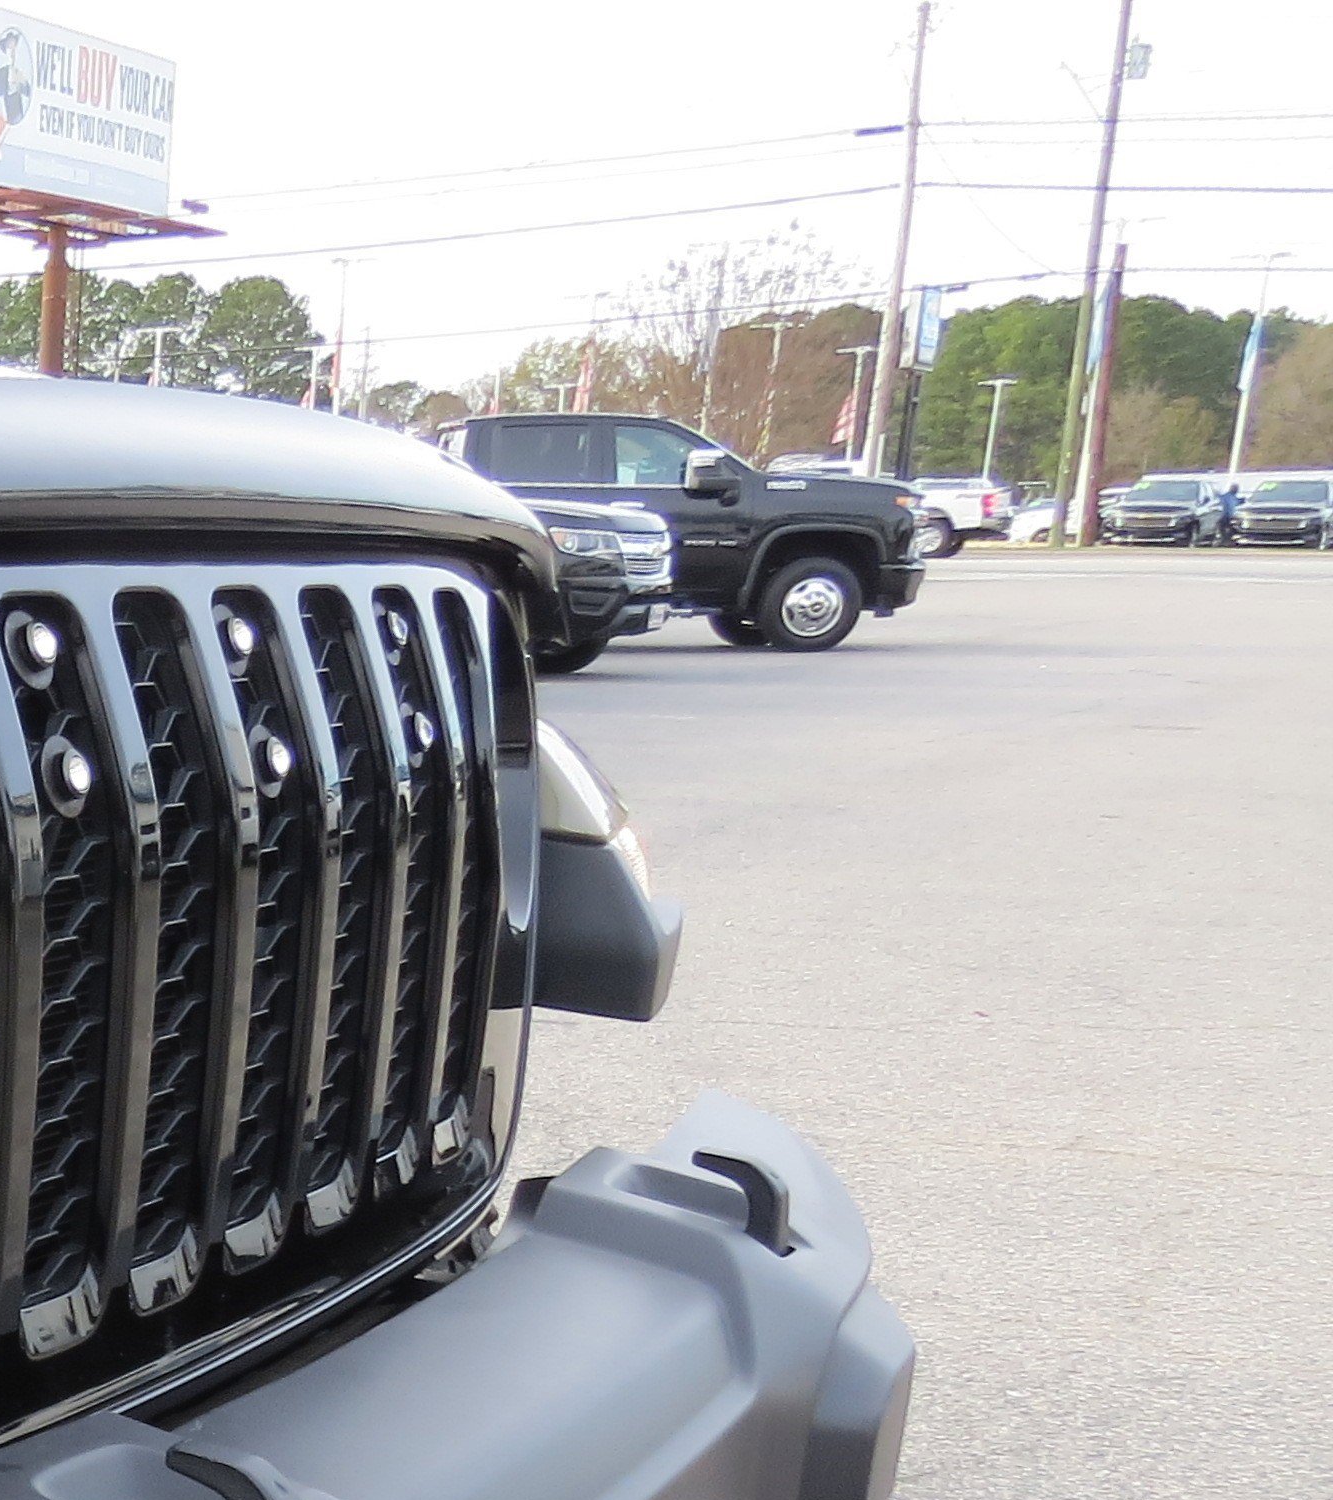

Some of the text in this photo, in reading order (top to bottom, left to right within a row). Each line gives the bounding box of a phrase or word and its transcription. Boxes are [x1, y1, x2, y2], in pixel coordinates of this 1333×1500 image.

[35, 40, 175, 124] WE'LL BUY YOUR CAR
[39, 103, 166, 163] EVEN IF YOU DON'T BUY OURS
